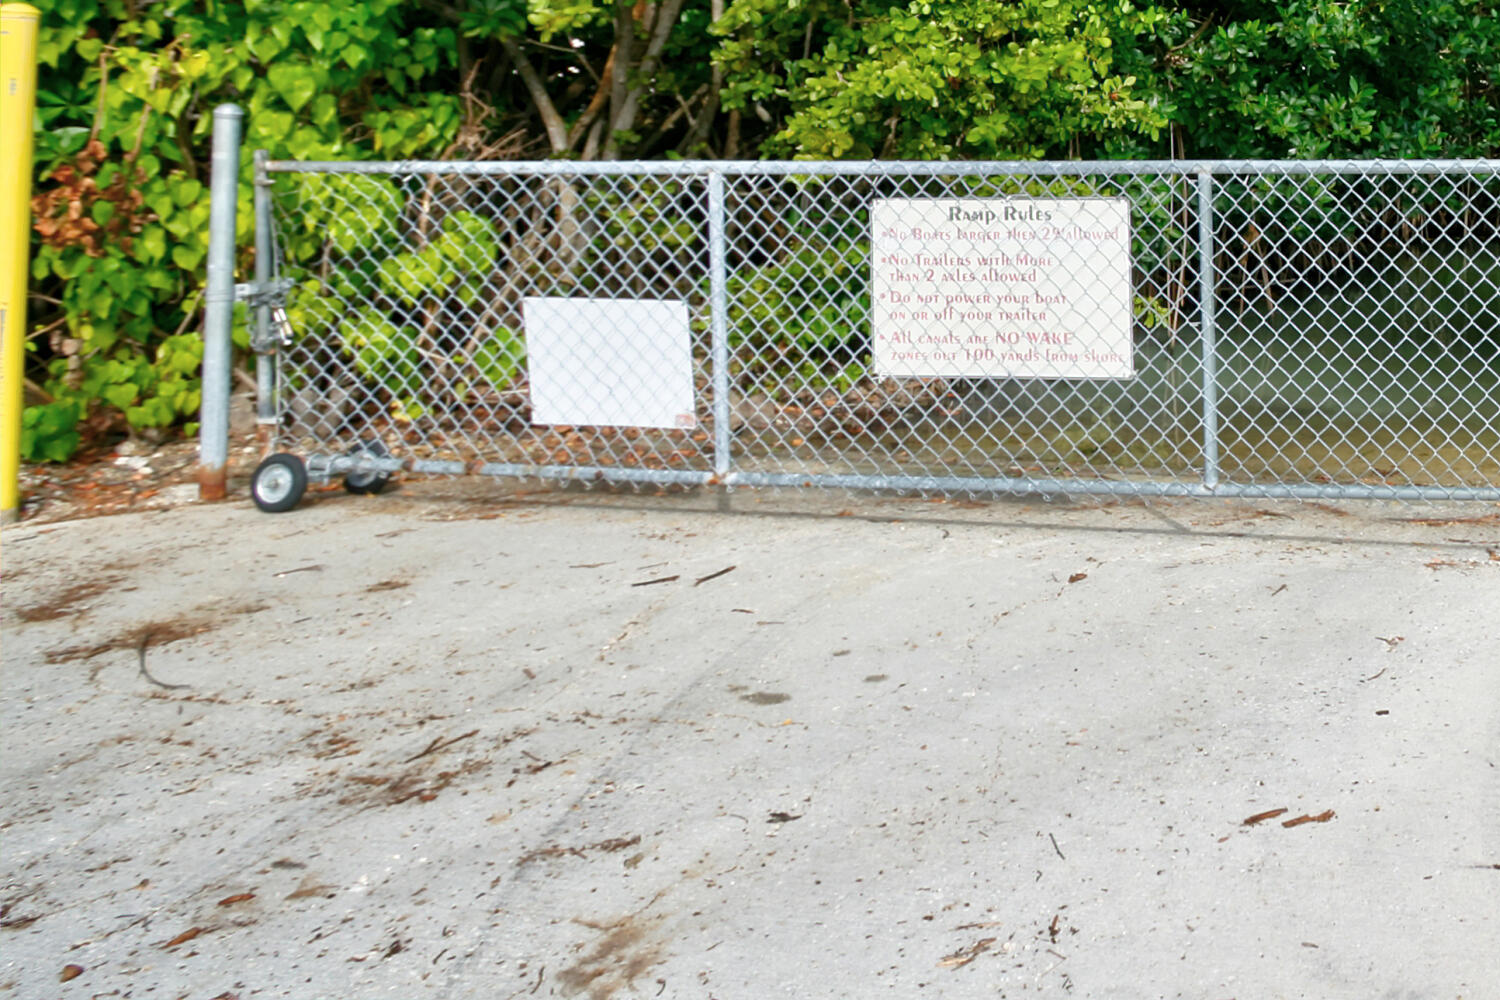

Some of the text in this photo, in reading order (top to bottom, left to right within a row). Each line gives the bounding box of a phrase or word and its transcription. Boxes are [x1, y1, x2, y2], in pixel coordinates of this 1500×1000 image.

[925, 269, 935, 282] 2
[995, 331, 1020, 345] NO
[1026, 331, 1074, 345] WAKE
